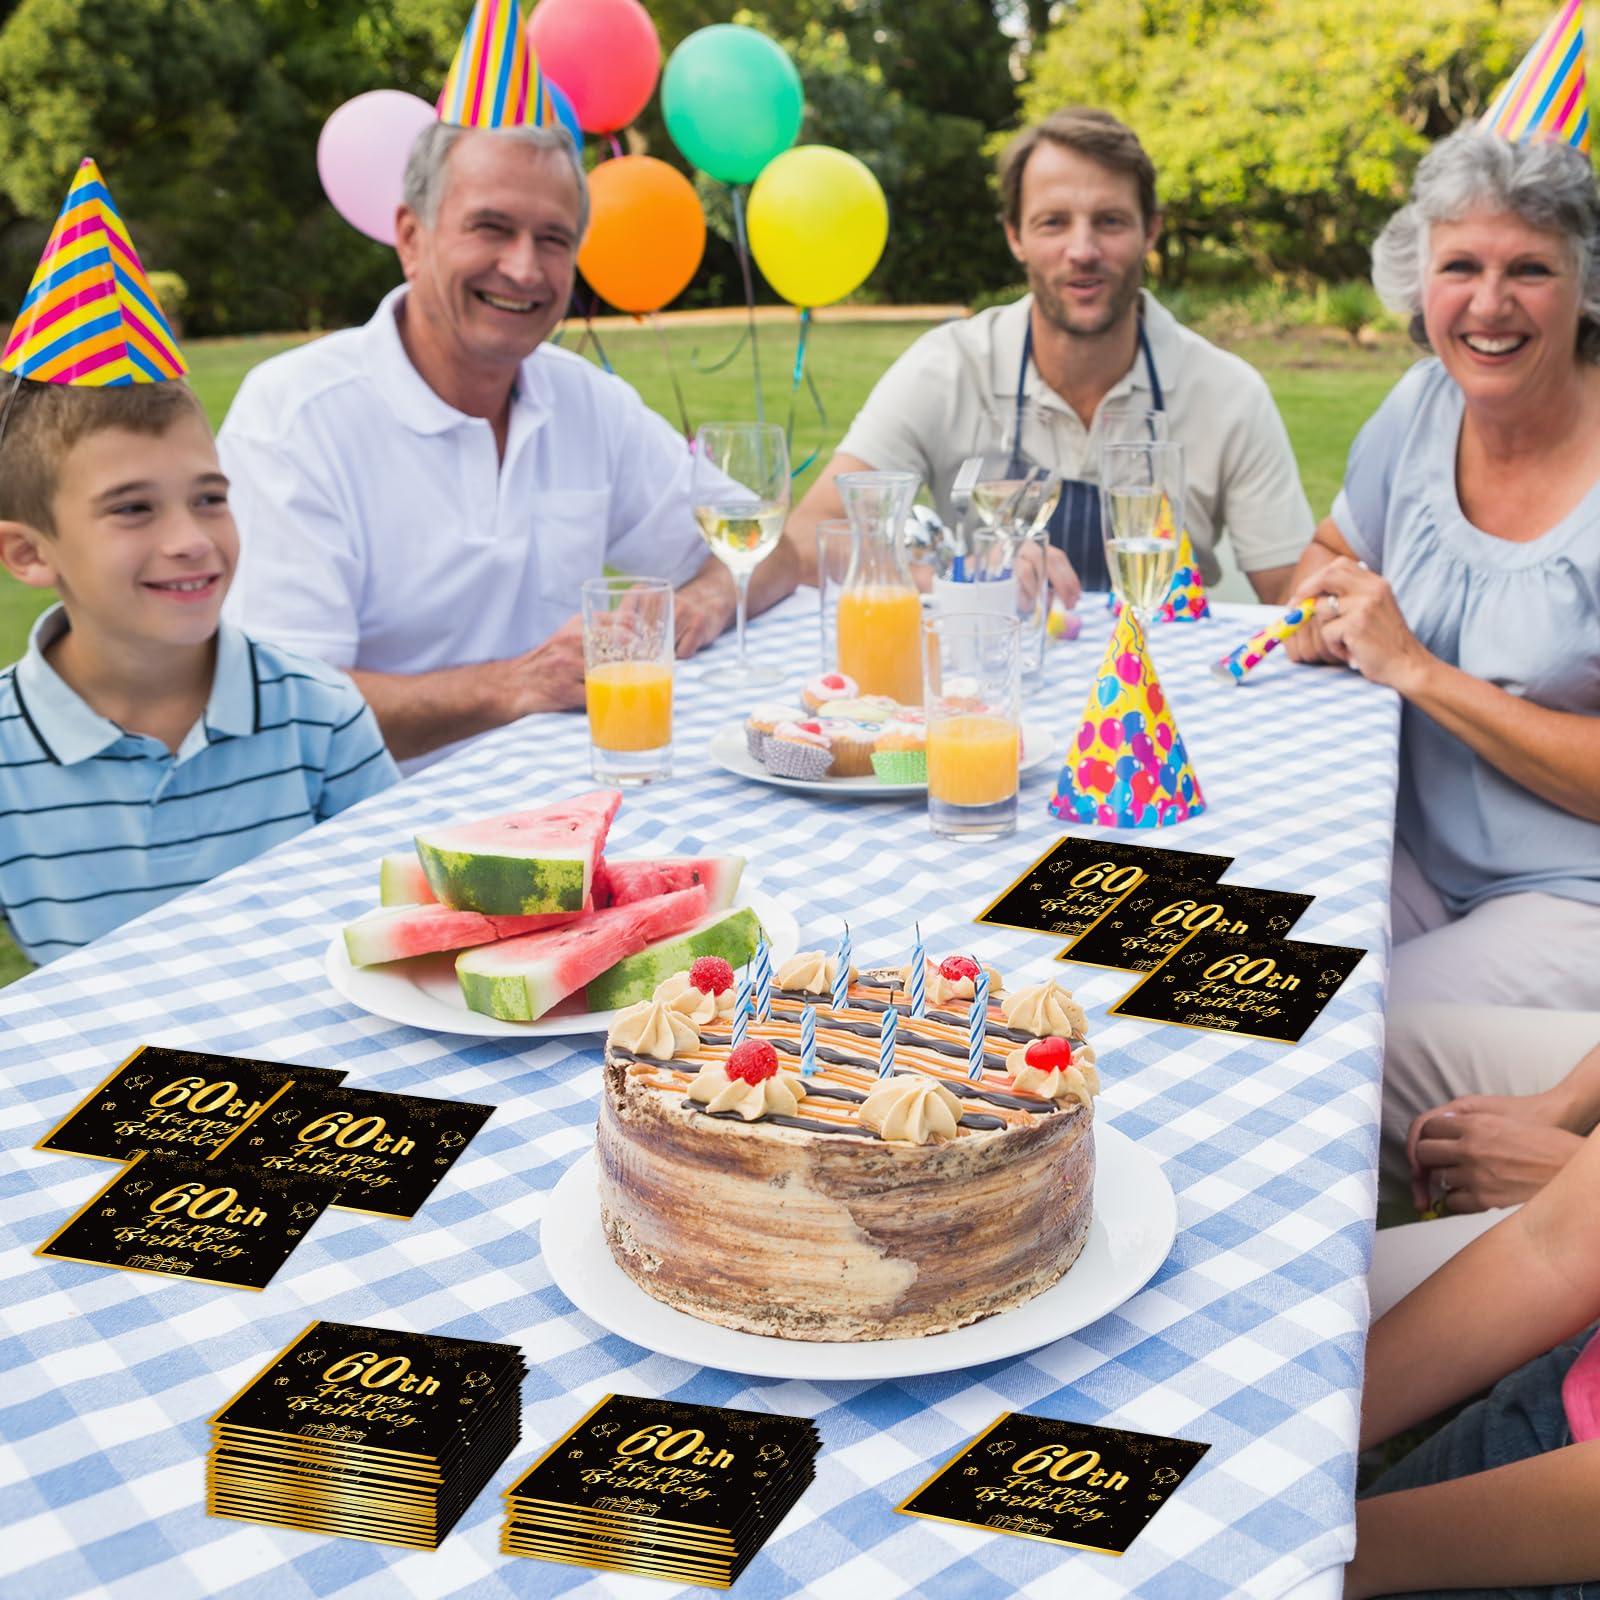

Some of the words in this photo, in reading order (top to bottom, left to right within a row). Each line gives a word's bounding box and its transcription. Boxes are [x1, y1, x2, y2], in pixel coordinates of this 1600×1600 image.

[1070, 861, 1144, 893] 60
[1040, 898, 1103, 917] Birth
[1063, 888, 1120, 905] Hap
[1151, 899, 1249, 935] 60th
[1202, 954, 1301, 992] 60th
[1172, 990, 1286, 1016] Birthday
[1196, 980, 1282, 1001] Happy
[113, 1120, 226, 1147] Birthda
[142, 1108, 240, 1134] Happy
[297, 1111, 416, 1156] 60th
[261, 1155, 398, 1187] Birthday
[289, 1143, 396, 1170] Happy
[149, 1182, 267, 1228] 60th
[113, 1225, 249, 1258] Birthday
[142, 1214, 248, 1242] Happy
[322, 1351, 441, 1396] 60th
[286, 1396, 423, 1427] Birthday
[314, 1383, 421, 1411] Happy
[616, 1424, 735, 1469] 60th
[609, 1456, 716, 1481] Happy
[1011, 1444, 1130, 1491] 60th
[580, 1467, 717, 1500] Birthday
[1003, 1474, 1110, 1502] Happy
[974, 1486, 1111, 1521] Birthday
